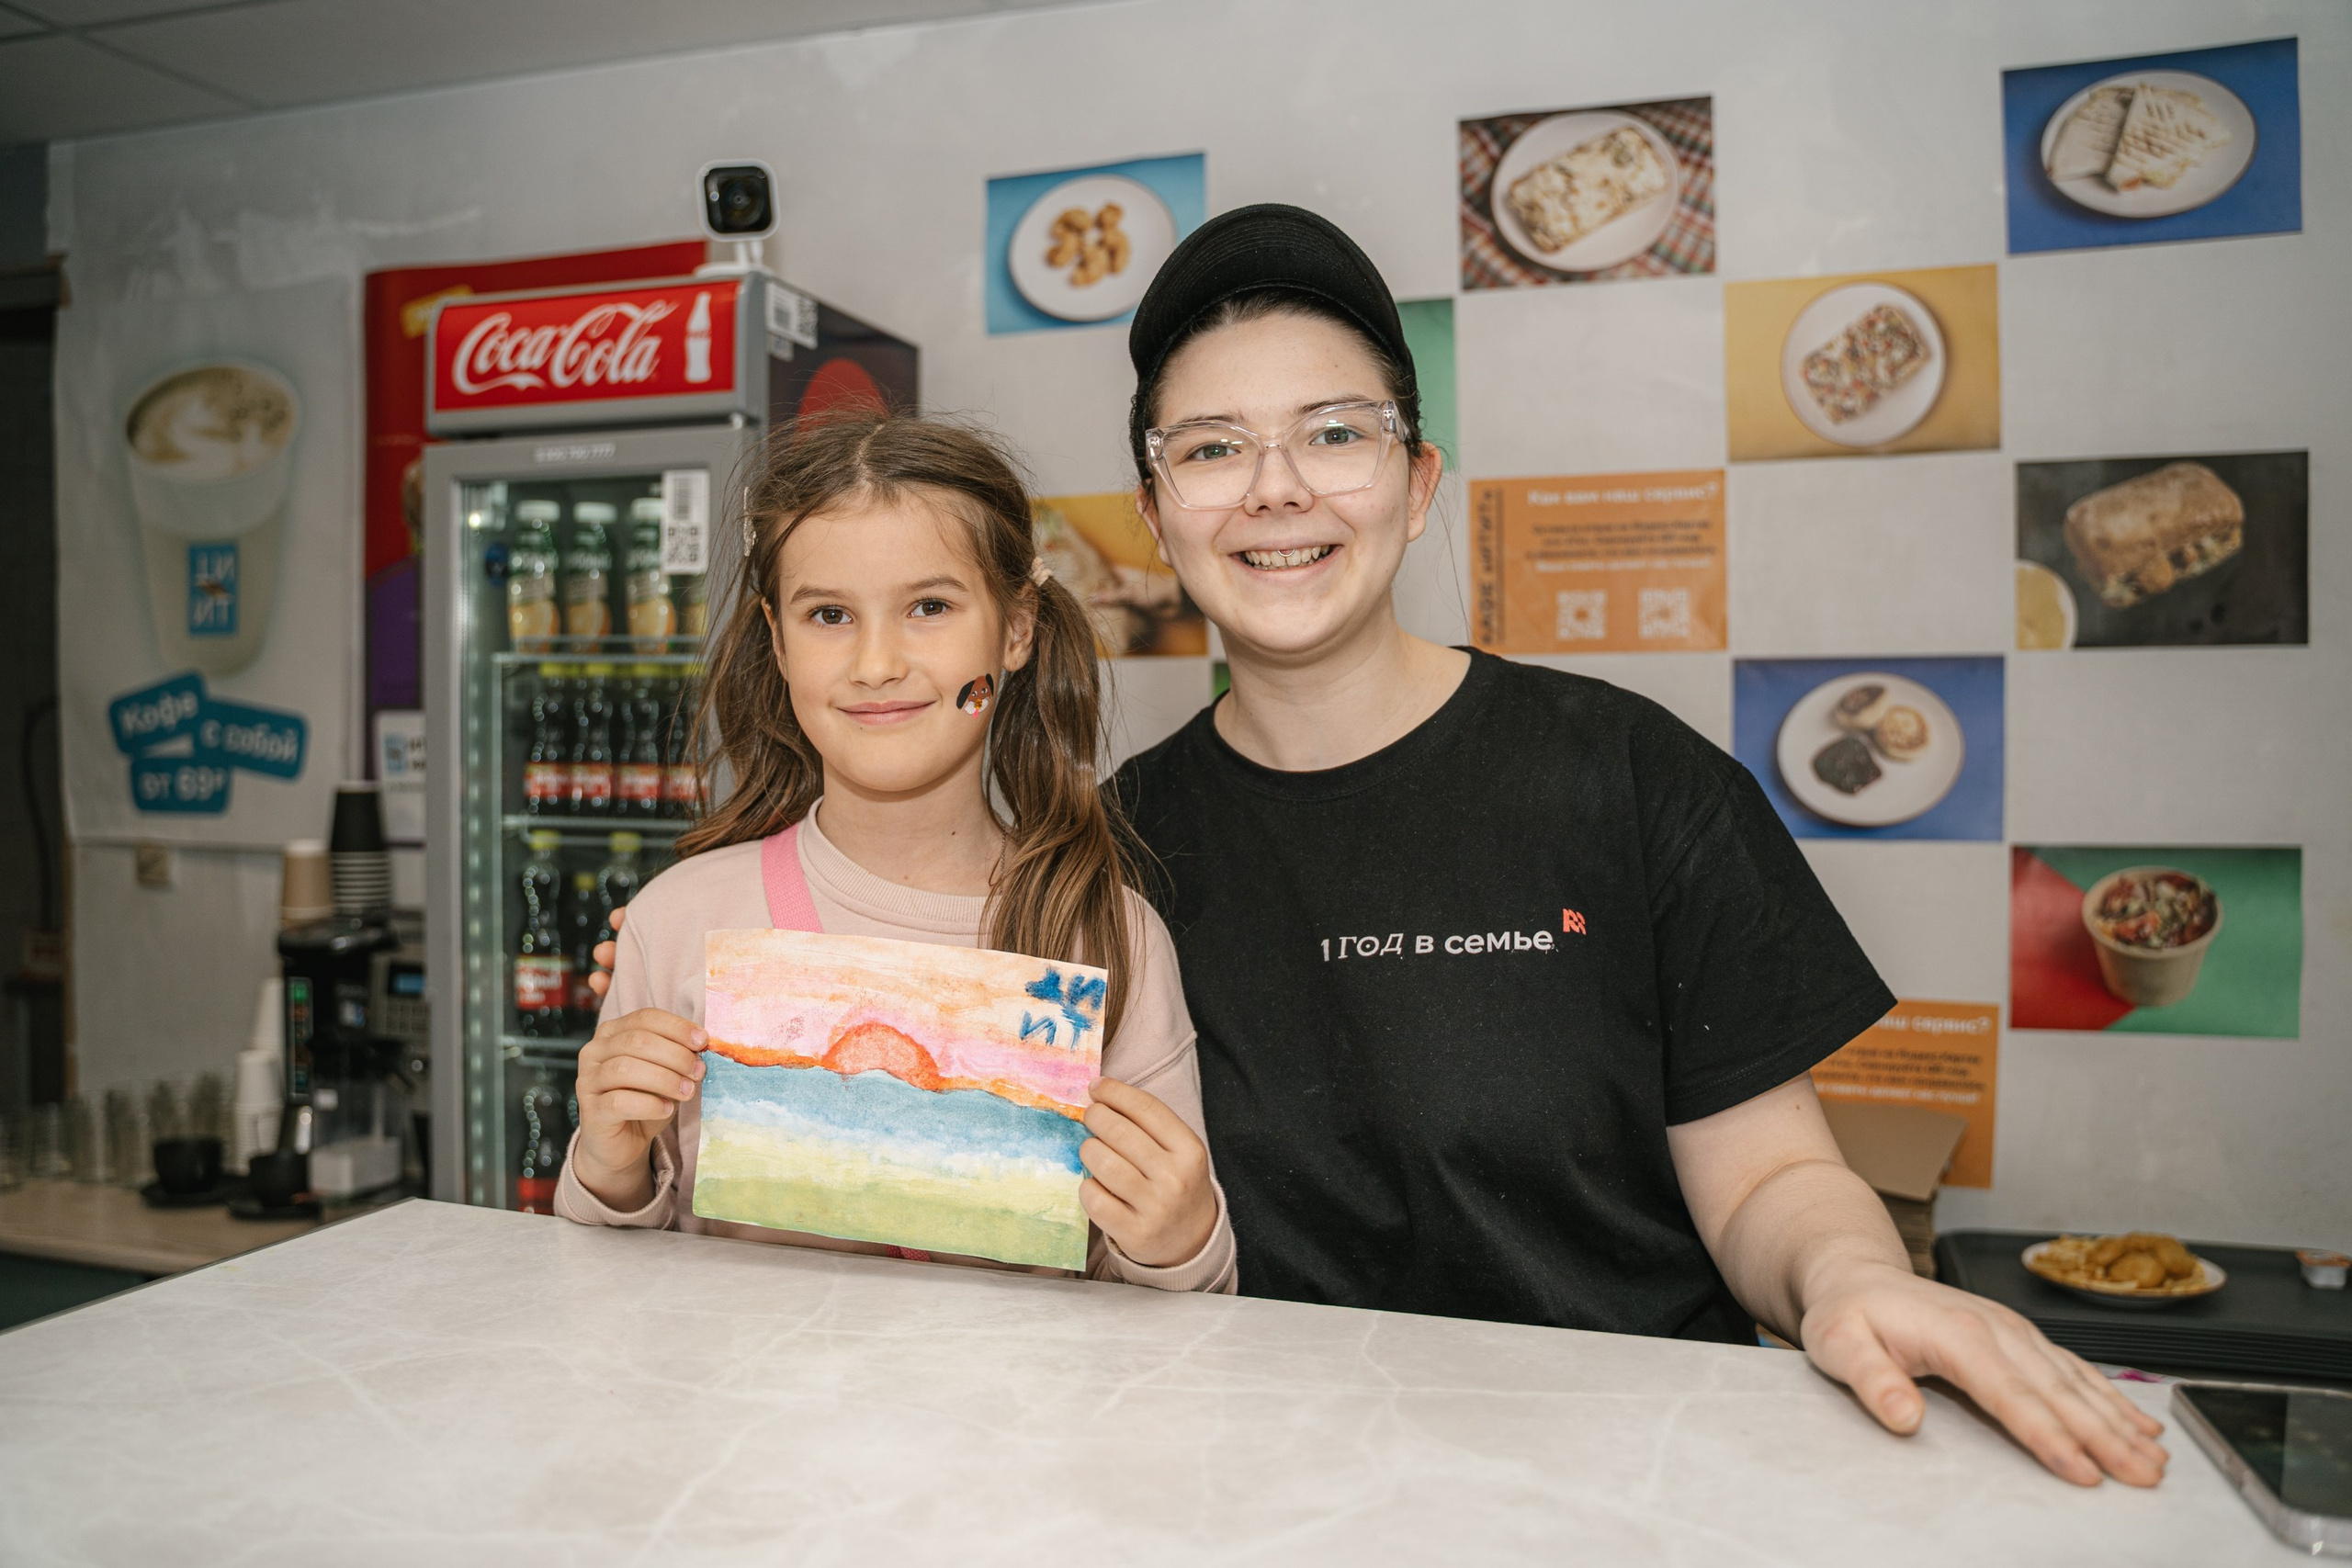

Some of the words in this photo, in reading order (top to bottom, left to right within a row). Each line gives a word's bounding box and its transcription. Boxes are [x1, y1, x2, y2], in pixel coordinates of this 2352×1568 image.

[451, 299, 680, 395] Coca-Cola
[1528, 489, 1561, 506] Как
[1565, 489, 1599, 504] вам
[1603, 487, 1640, 503] наш
[1643, 482, 1719, 504] сервис?
[119, 692, 198, 738] Кофе
[200, 721, 220, 748] с
[224, 723, 297, 763] собой
[140, 774, 172, 800] от
[1320, 938, 1330, 962] 1
[1444, 930, 1555, 955] семье
[1879, 1015, 1908, 1030] аш
[1912, 1016, 1991, 1035] сервис?
